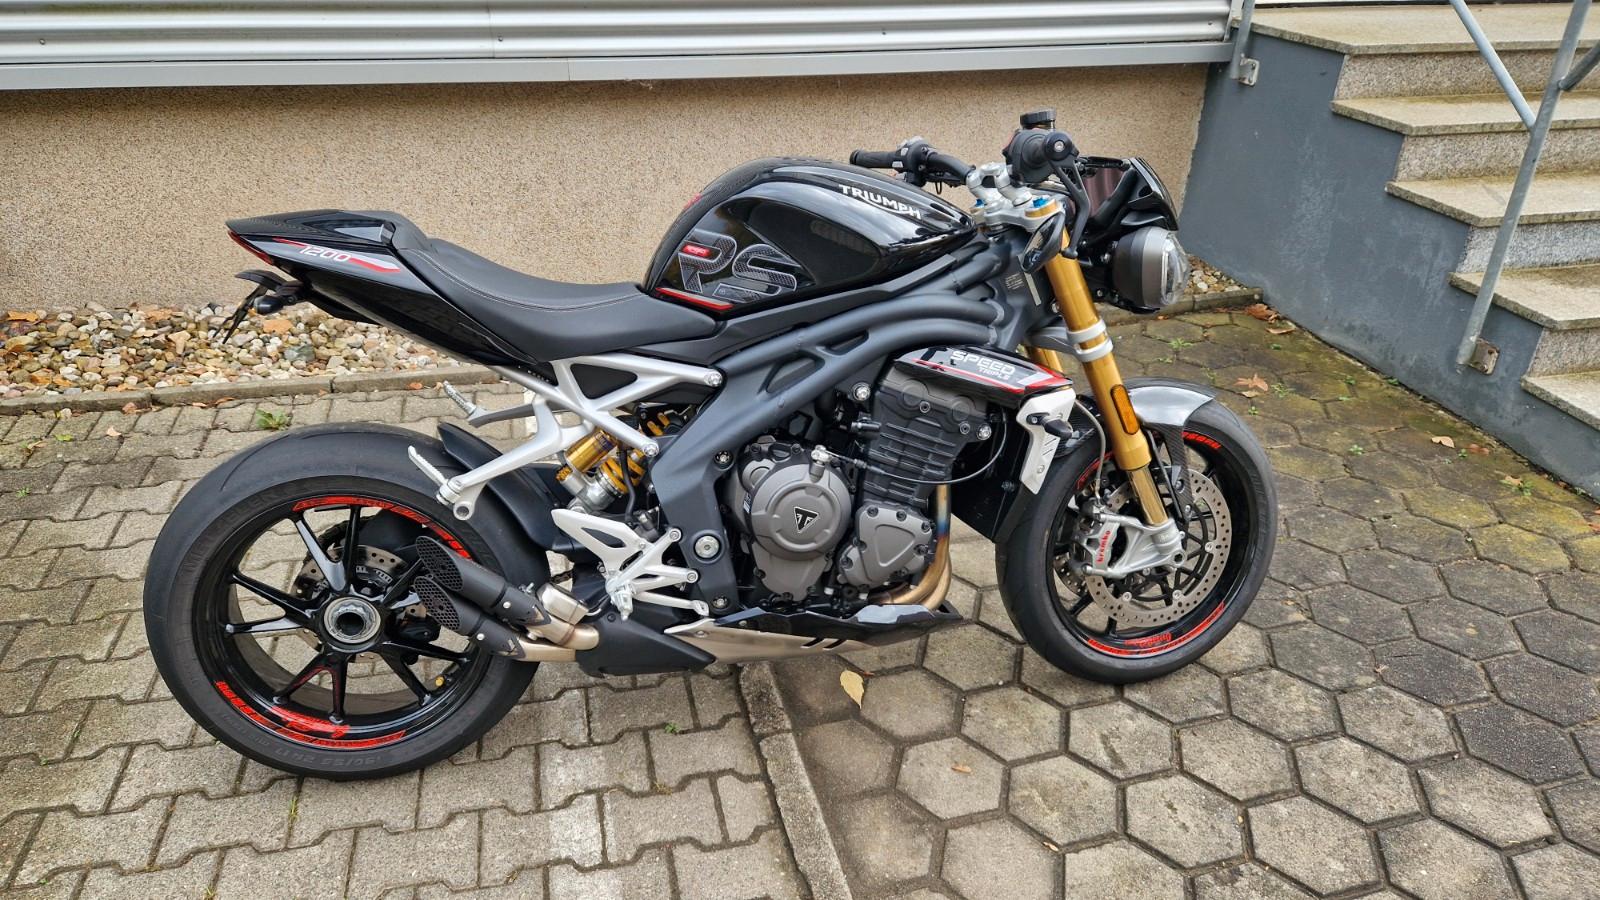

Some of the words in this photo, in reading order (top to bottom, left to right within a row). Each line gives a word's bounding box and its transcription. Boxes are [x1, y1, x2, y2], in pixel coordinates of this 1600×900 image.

[839, 184, 921, 219] TRIUMPH
[300, 245, 350, 262] 1200
[677, 228, 801, 303] RS
[951, 351, 1016, 375] SPEED
[1097, 530, 1111, 564] brembo
